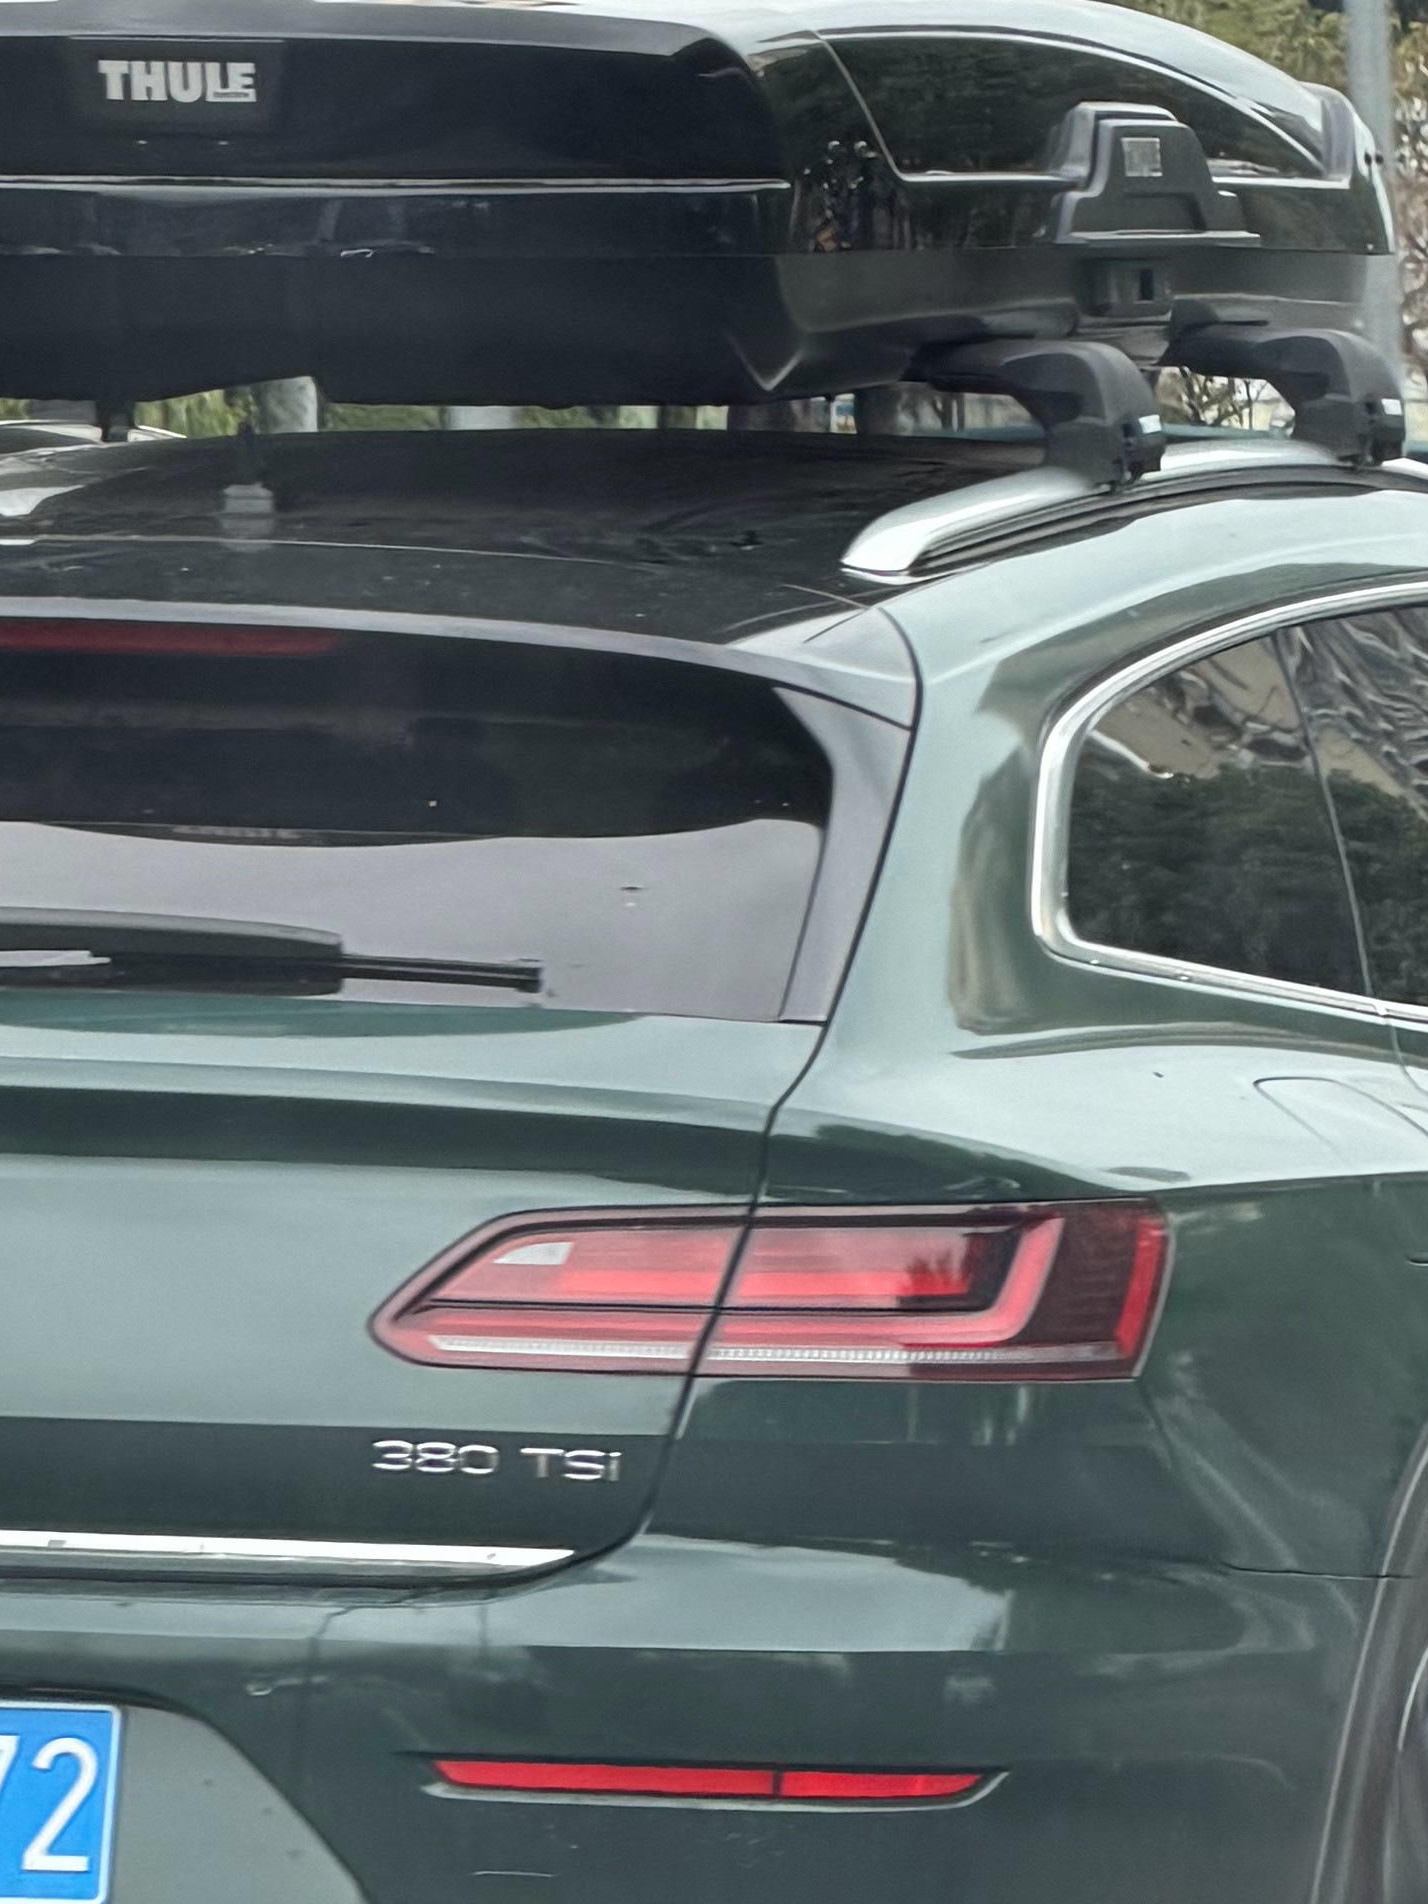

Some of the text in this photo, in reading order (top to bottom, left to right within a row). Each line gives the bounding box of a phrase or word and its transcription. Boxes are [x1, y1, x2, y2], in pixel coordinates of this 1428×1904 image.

[97, 59, 257, 103] THULE
[371, 1438, 622, 1482] 380 TSI
